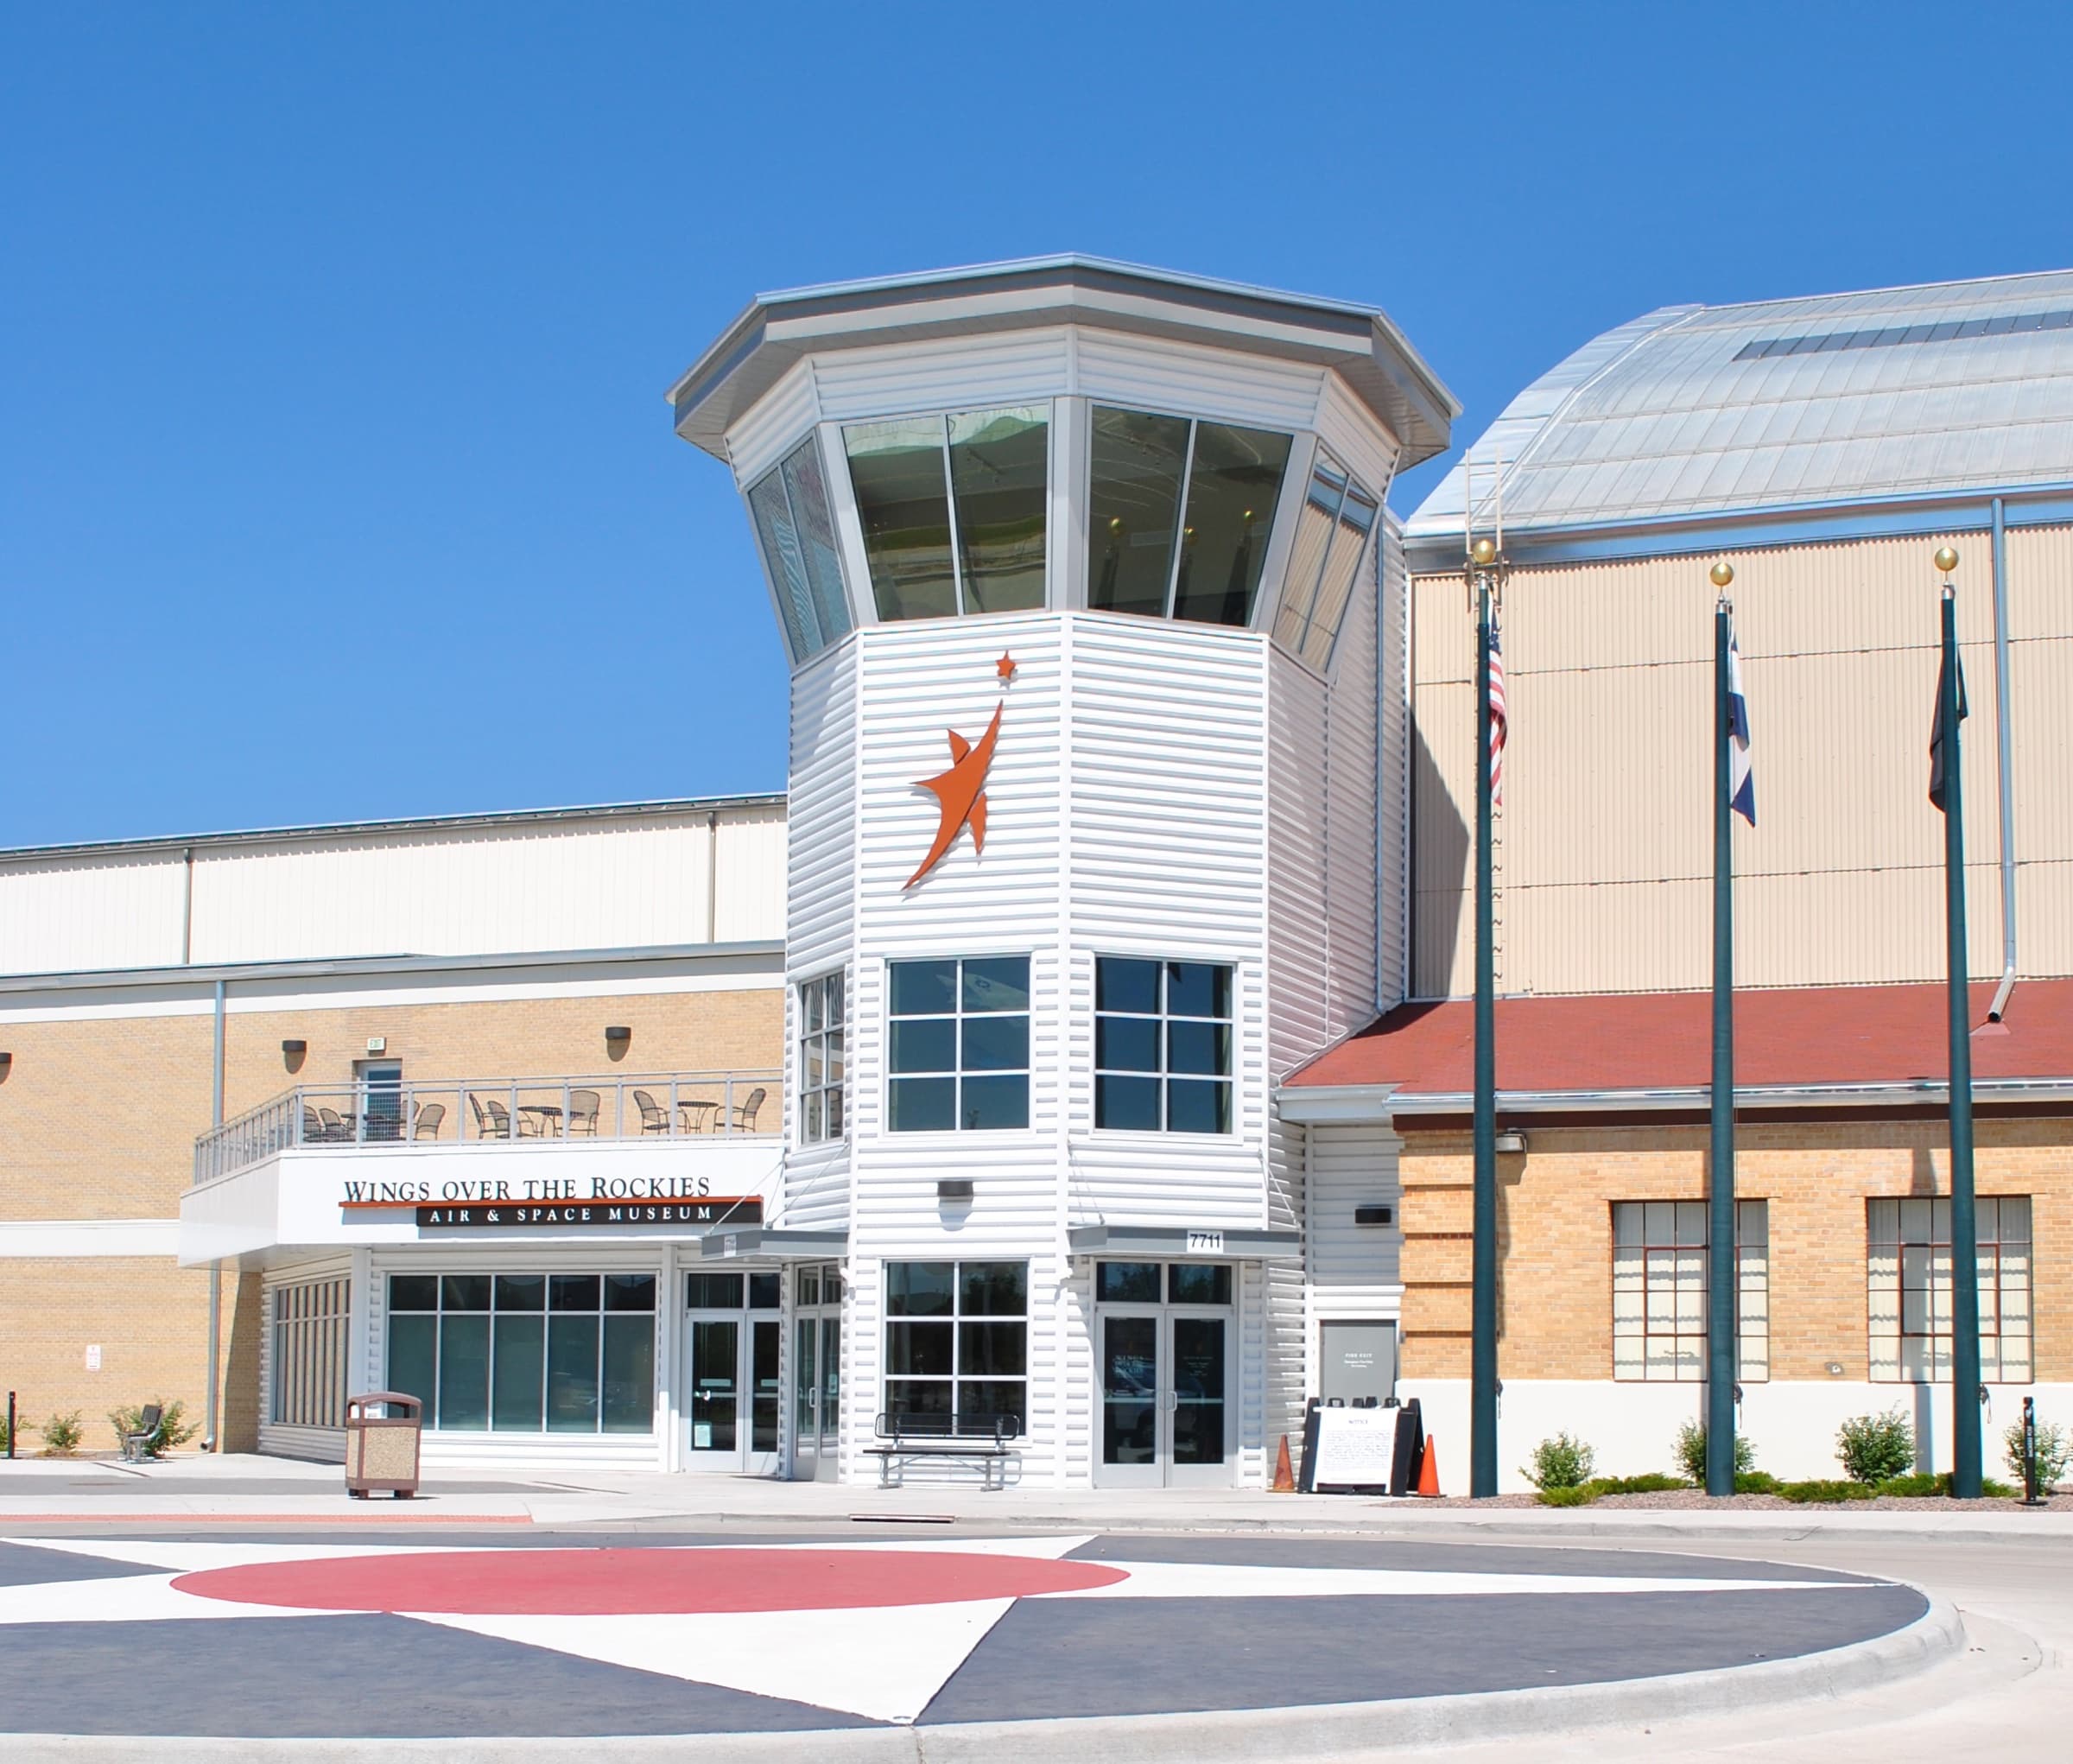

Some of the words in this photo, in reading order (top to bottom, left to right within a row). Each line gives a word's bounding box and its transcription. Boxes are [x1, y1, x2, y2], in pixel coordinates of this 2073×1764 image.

[344, 1180, 430, 1202] WINGS
[442, 1180, 511, 1201] OVER
[523, 1179, 577, 1200] THE
[591, 1177, 711, 1198] ROCKIES
[430, 1209, 470, 1222] AIR
[487, 1209, 499, 1221] &
[518, 1208, 592, 1221] SPACE
[608, 1206, 712, 1221] MUSEUM
[1189, 1234, 1220, 1248] 7711
